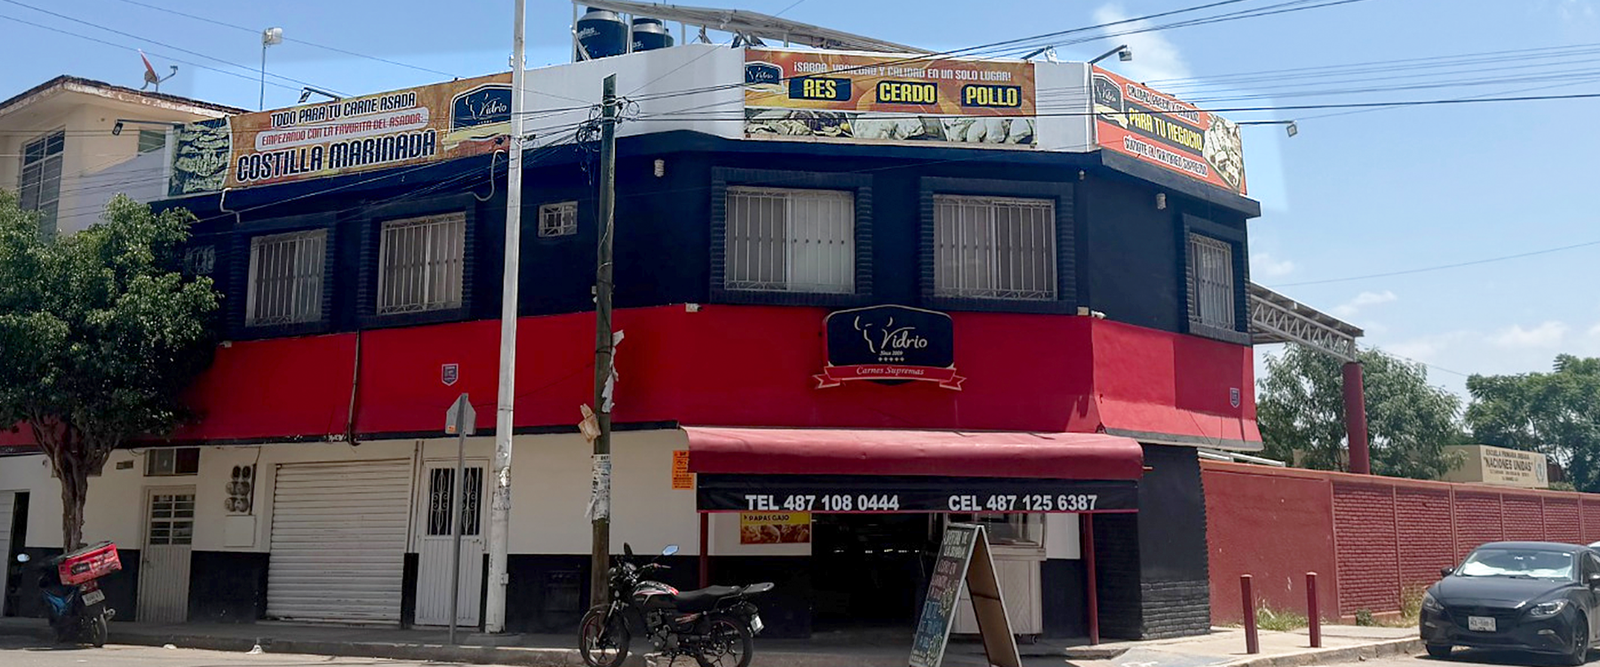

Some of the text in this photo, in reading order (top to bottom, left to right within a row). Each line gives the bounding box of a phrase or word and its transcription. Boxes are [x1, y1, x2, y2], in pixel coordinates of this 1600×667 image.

[879, 66, 885, 76] Y
[888, 66, 925, 78] CALIDAD
[928, 69, 939, 79] EN
[941, 69, 954, 79] UN
[956, 70, 978, 80] SOLO
[980, 70, 1011, 82] LUGAR!
[803, 78, 837, 99] RES
[879, 82, 935, 104] CERDO
[966, 86, 1017, 107] POLLO
[271, 92, 416, 127] TODO PARA TU CARNE ASADA
[479, 97, 507, 116] Vidrio
[262, 130, 306, 147] EMPEZANDO
[307, 128, 322, 140] CON
[324, 126, 333, 137] LA
[335, 122, 371, 136] FAVORITA
[373, 118, 387, 130] DEL
[1129, 107, 1203, 151] PARA TU NEGOCIO
[236, 129, 436, 182] COSTILLA MARINADA
[881, 327, 927, 349] Vidrio
[856, 366, 924, 376] Carnes Supremas
[1483, 457, 1533, 471] "NACIONES UNIDAS"
[745, 494, 899, 511] TEL 487 108 0444
[948, 494, 1098, 511] CEL 487 125 6387
